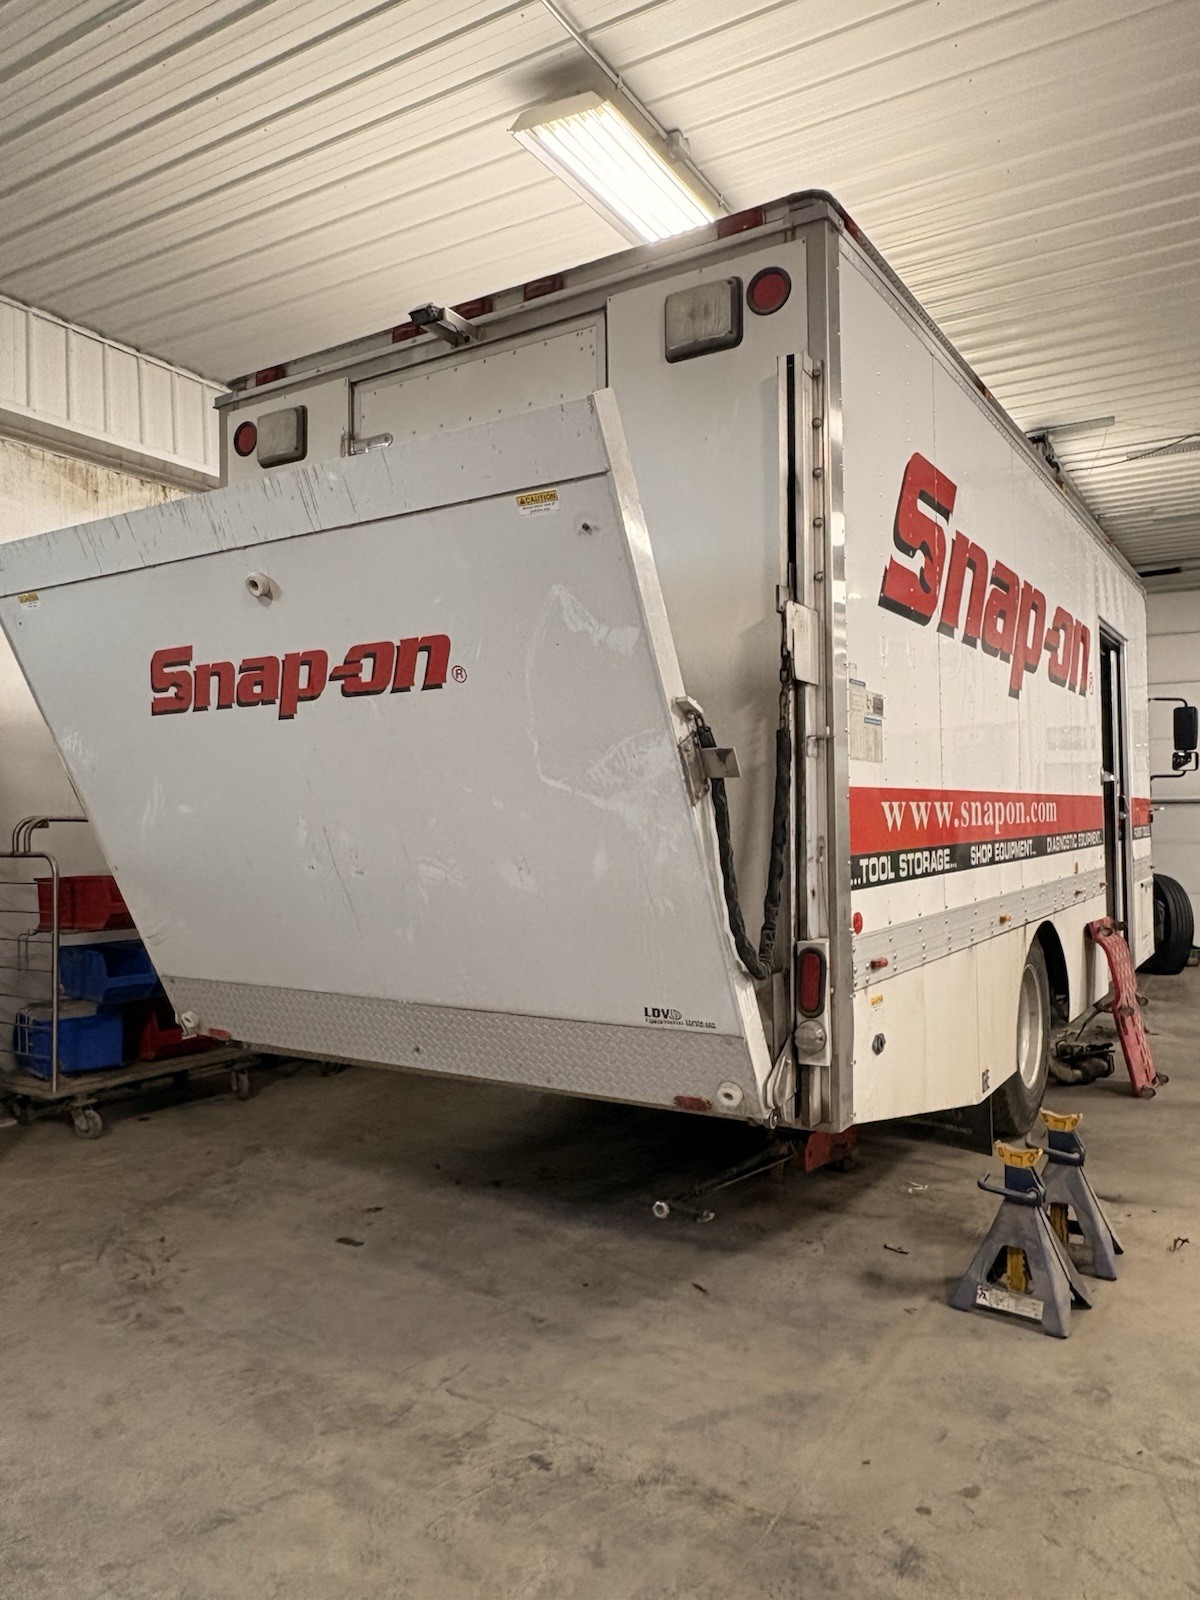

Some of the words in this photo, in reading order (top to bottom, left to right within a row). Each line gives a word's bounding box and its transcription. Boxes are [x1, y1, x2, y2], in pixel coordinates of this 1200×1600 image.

[525, 492, 556, 504] CAUTION
[877, 451, 1092, 700] Snap-on
[150, 634, 451, 720] Snap-on
[881, 801, 1058, 834] www.snapon.com
[970, 843, 993, 866] SHOP
[644, 1007, 670, 1019] LDV
